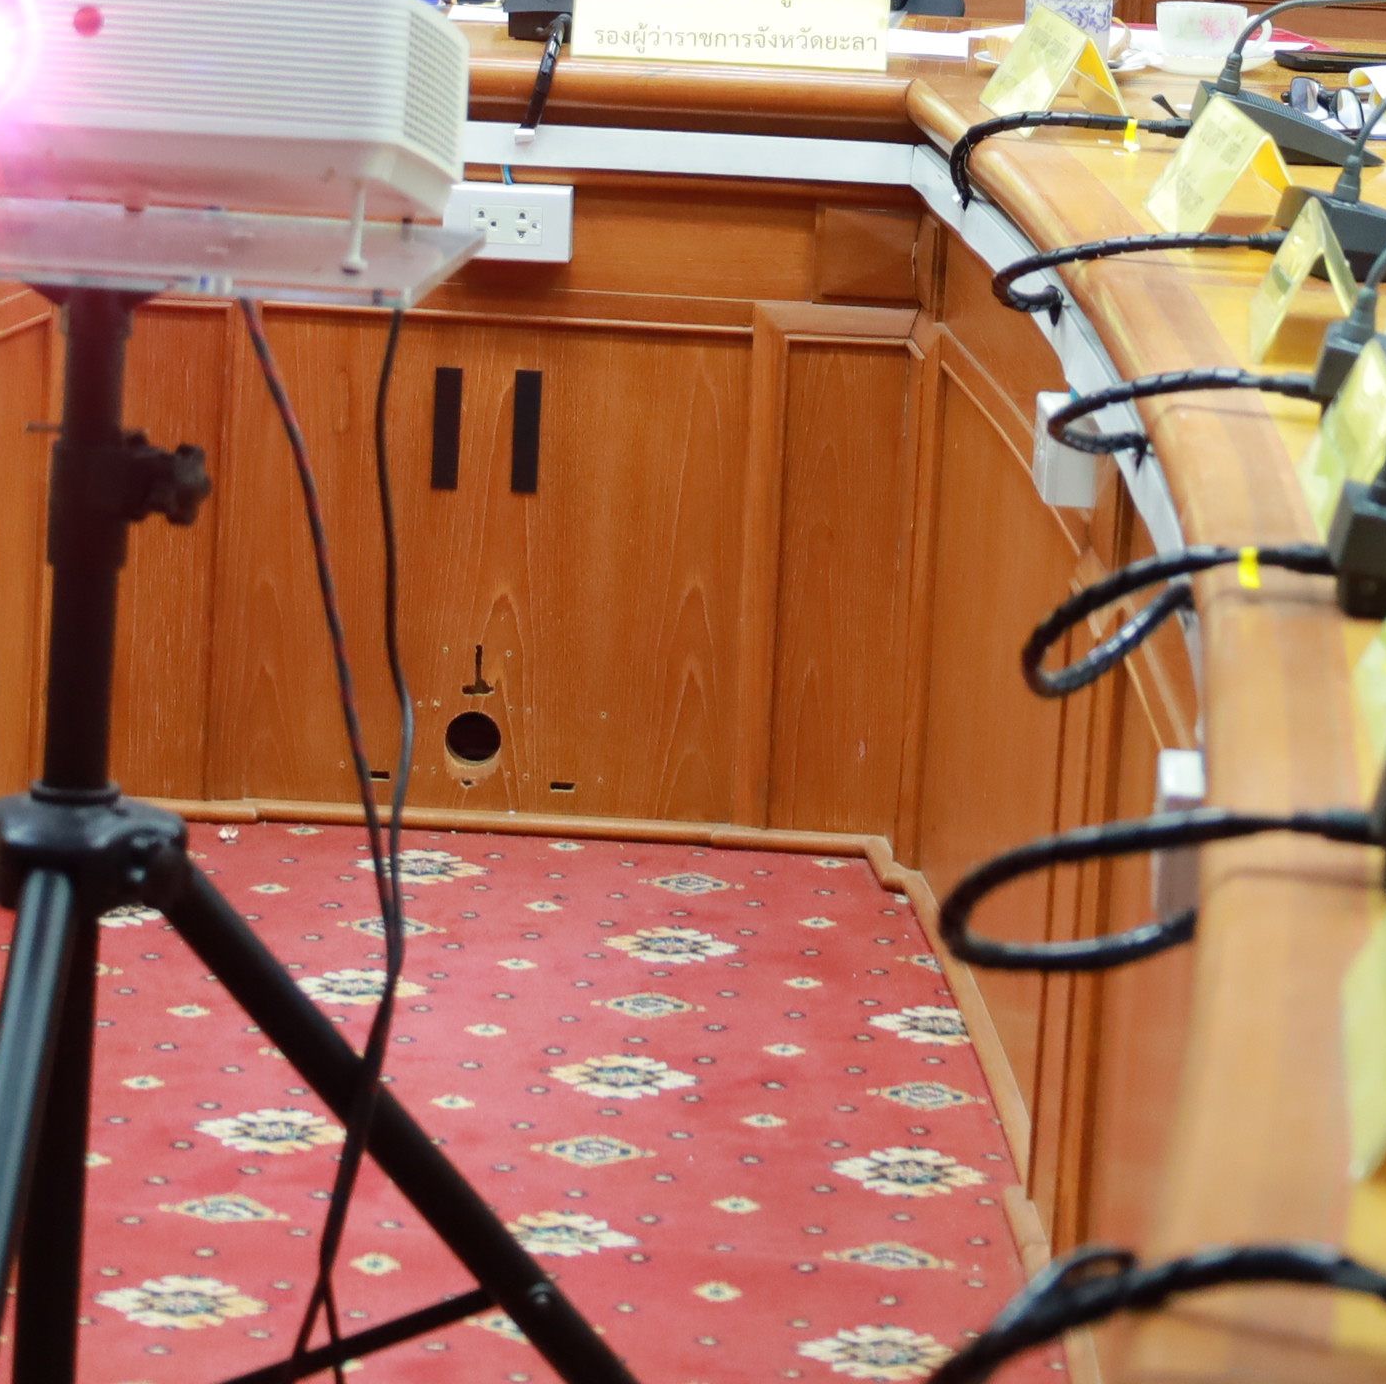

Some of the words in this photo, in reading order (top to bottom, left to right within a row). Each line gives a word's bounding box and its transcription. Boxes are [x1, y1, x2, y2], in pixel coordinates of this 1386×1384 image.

[593, 21, 879, 56] รองผู้ว่าราชการจังหวัดยะลา
